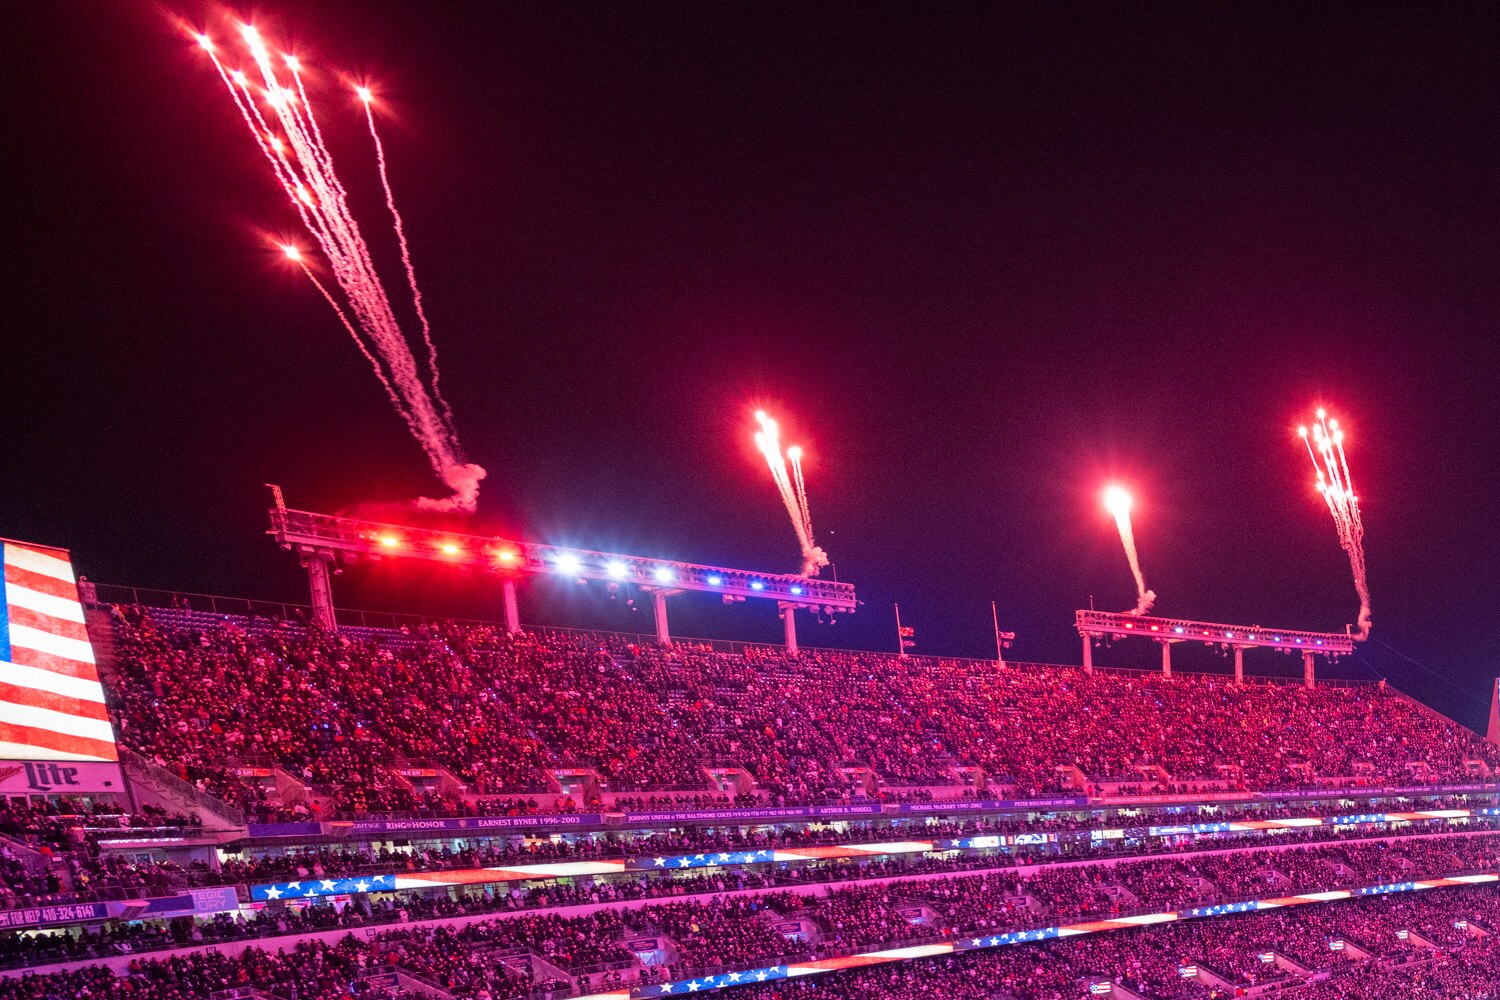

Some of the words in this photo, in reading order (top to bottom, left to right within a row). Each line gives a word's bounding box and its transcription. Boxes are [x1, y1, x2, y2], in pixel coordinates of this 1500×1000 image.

[23, 762, 79, 791] Lite
[412, 820, 445, 829] HONOR
[513, 817, 538, 825] BYNER
[540, 816, 580, 824] 1996-2003
[43, 905, 95, 922] 410-324-6141
